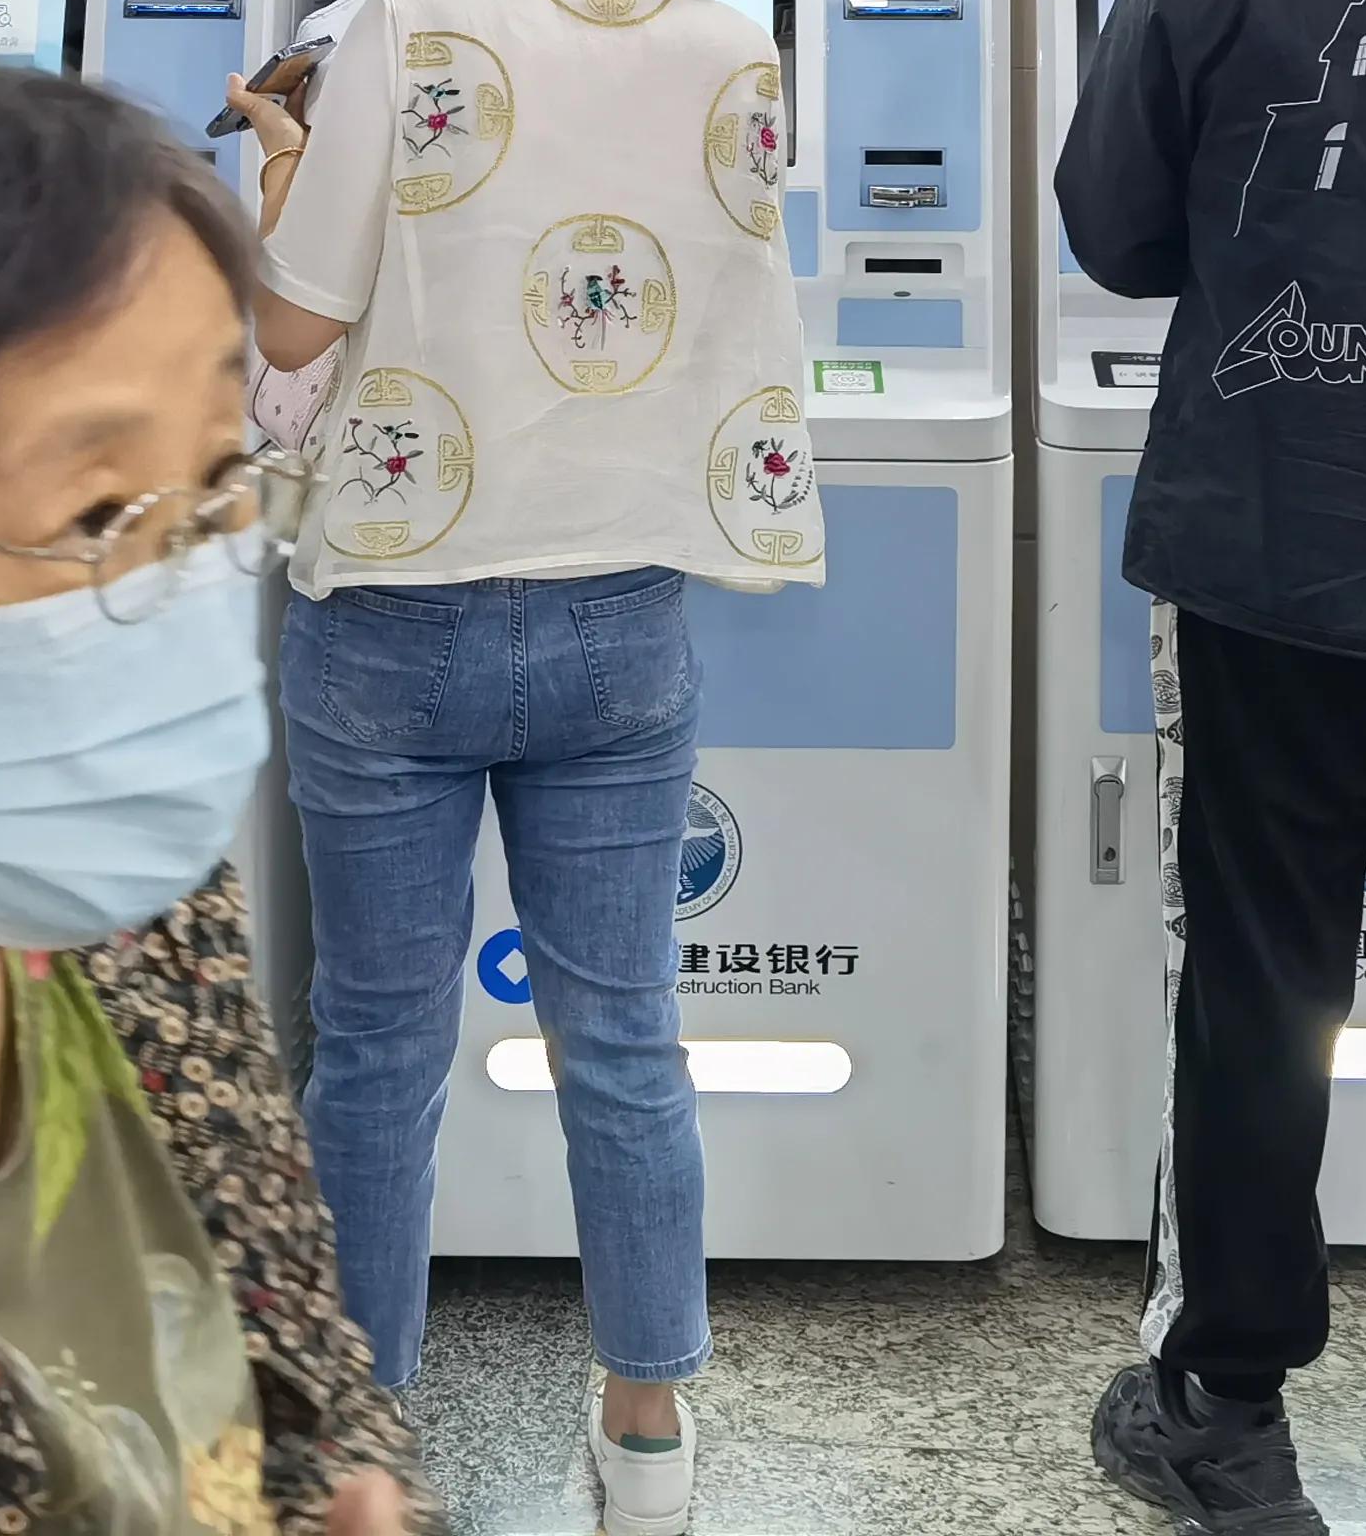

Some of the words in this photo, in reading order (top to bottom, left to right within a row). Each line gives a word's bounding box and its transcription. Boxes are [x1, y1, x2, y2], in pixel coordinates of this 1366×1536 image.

[678, 943, 860, 976] 建设银行
[770, 978, 822, 995] Bank
